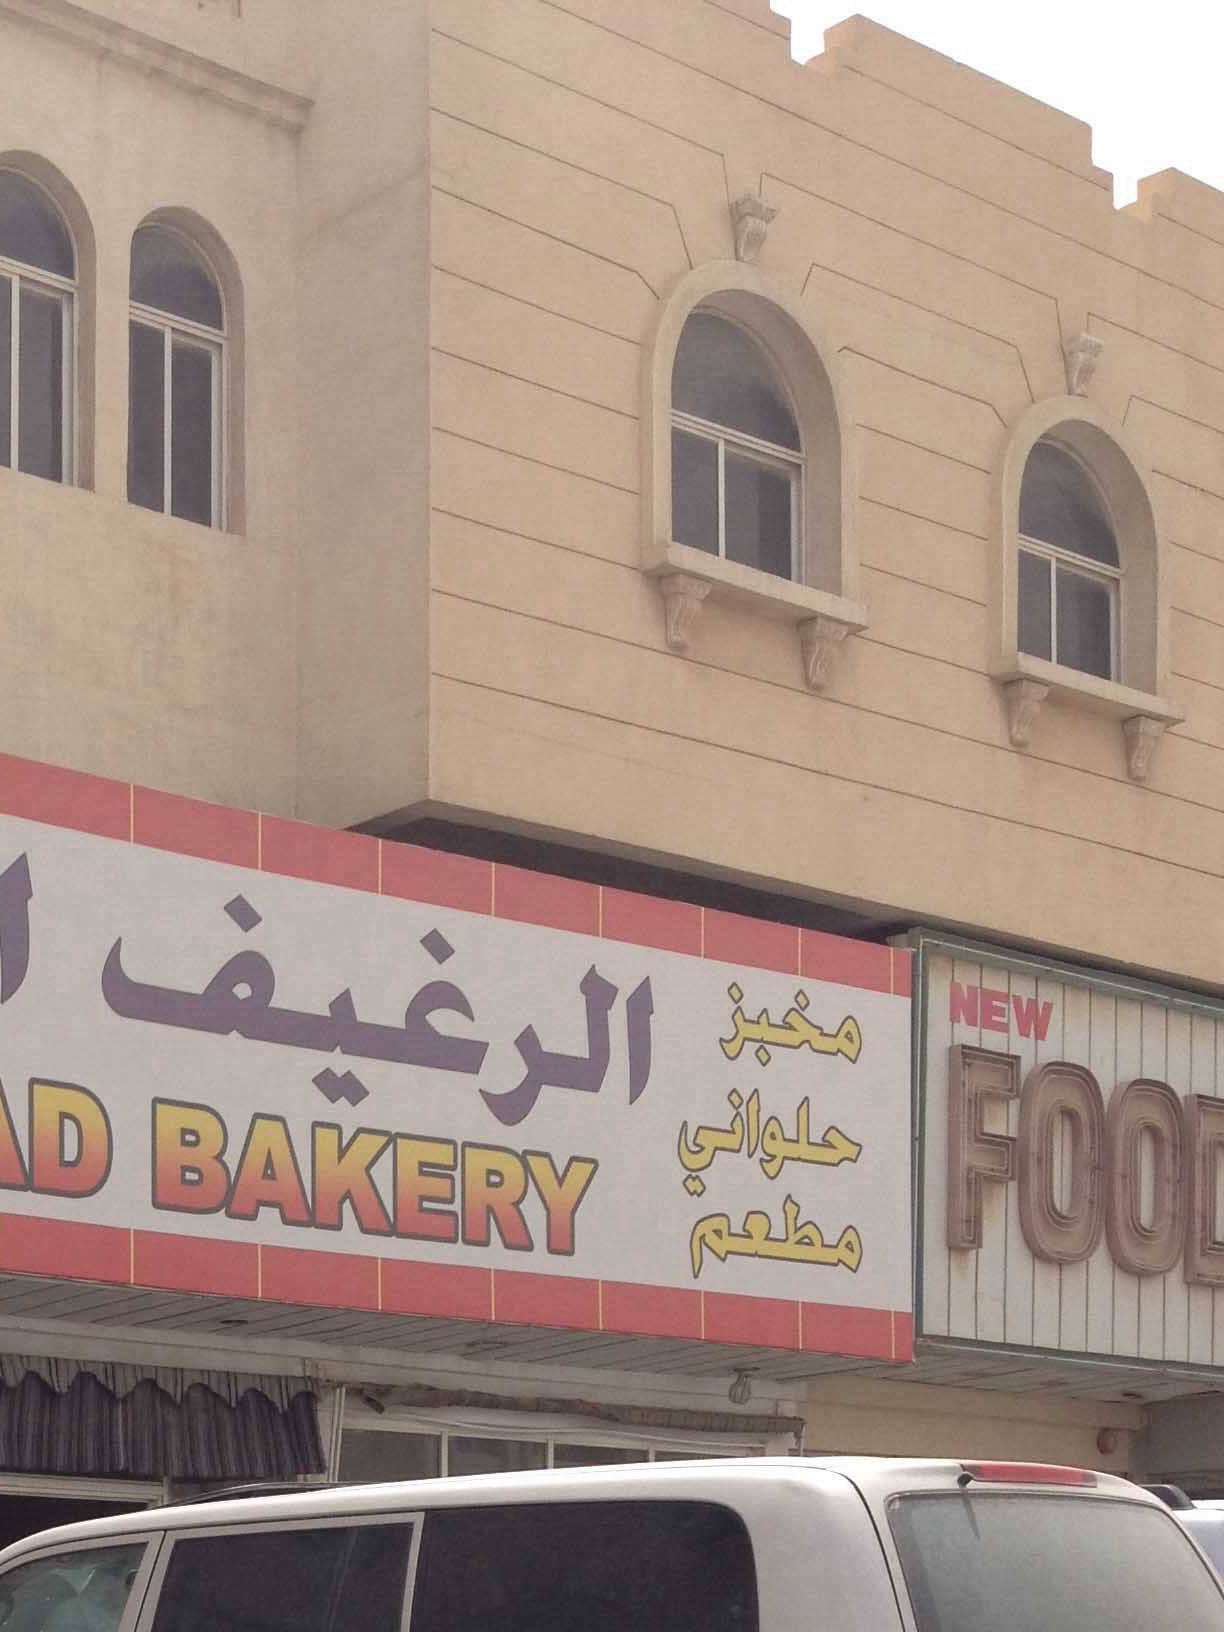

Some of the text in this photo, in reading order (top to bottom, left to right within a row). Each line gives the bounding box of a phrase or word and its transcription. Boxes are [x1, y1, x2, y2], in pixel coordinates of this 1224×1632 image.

[101, 894, 654, 1126] الرغيف
[719, 981, 863, 1066] مخبز
[949, 980, 1054, 1041] NEW
[151, 1096, 598, 1256] BAKERY
[677, 1088, 863, 1197] حلواني
[689, 1194, 863, 1279] مطعم
